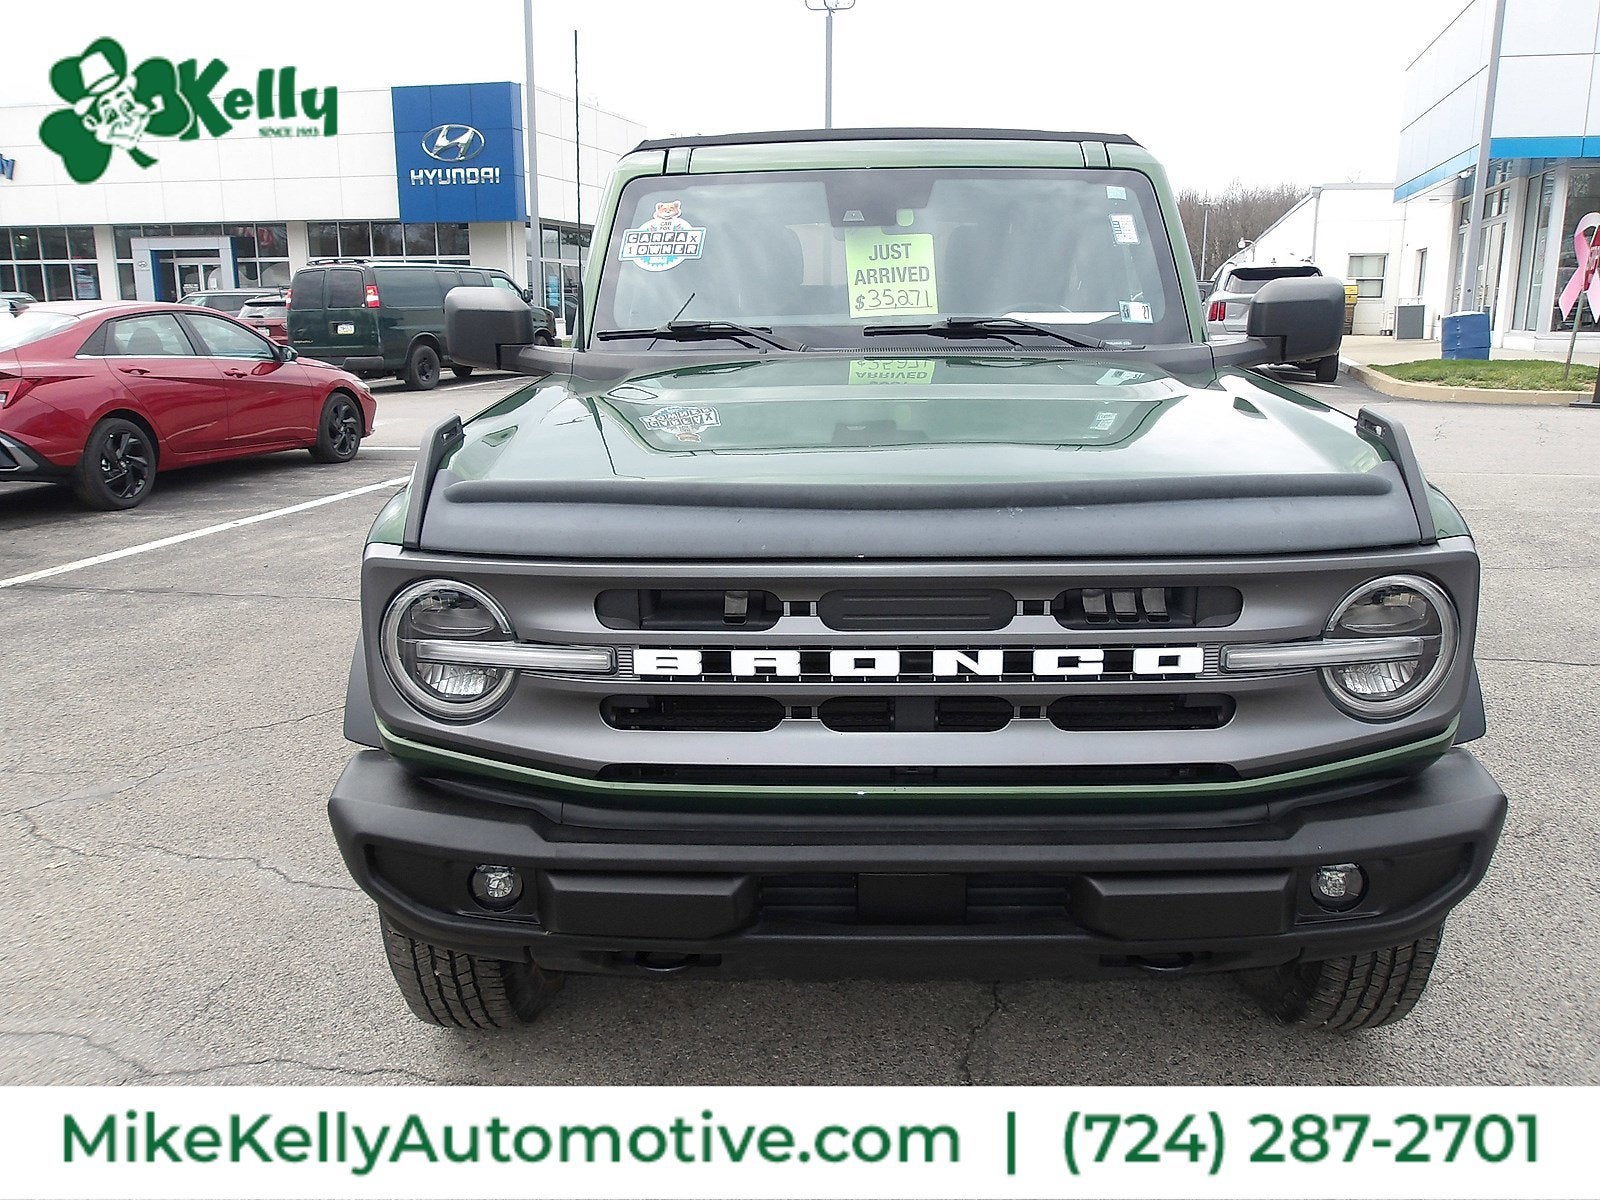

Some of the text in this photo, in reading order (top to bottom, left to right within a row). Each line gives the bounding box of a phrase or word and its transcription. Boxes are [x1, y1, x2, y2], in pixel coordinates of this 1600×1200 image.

[409, 166, 501, 186] HYUNDAI
[627, 231, 698, 243] CARFAX
[636, 243, 698, 255] OWNER
[868, 243, 912, 261] JUST
[854, 266, 930, 285] ARRIVED
[854, 288, 932, 311] $35,271
[633, 647, 1204, 677] BRONCO
